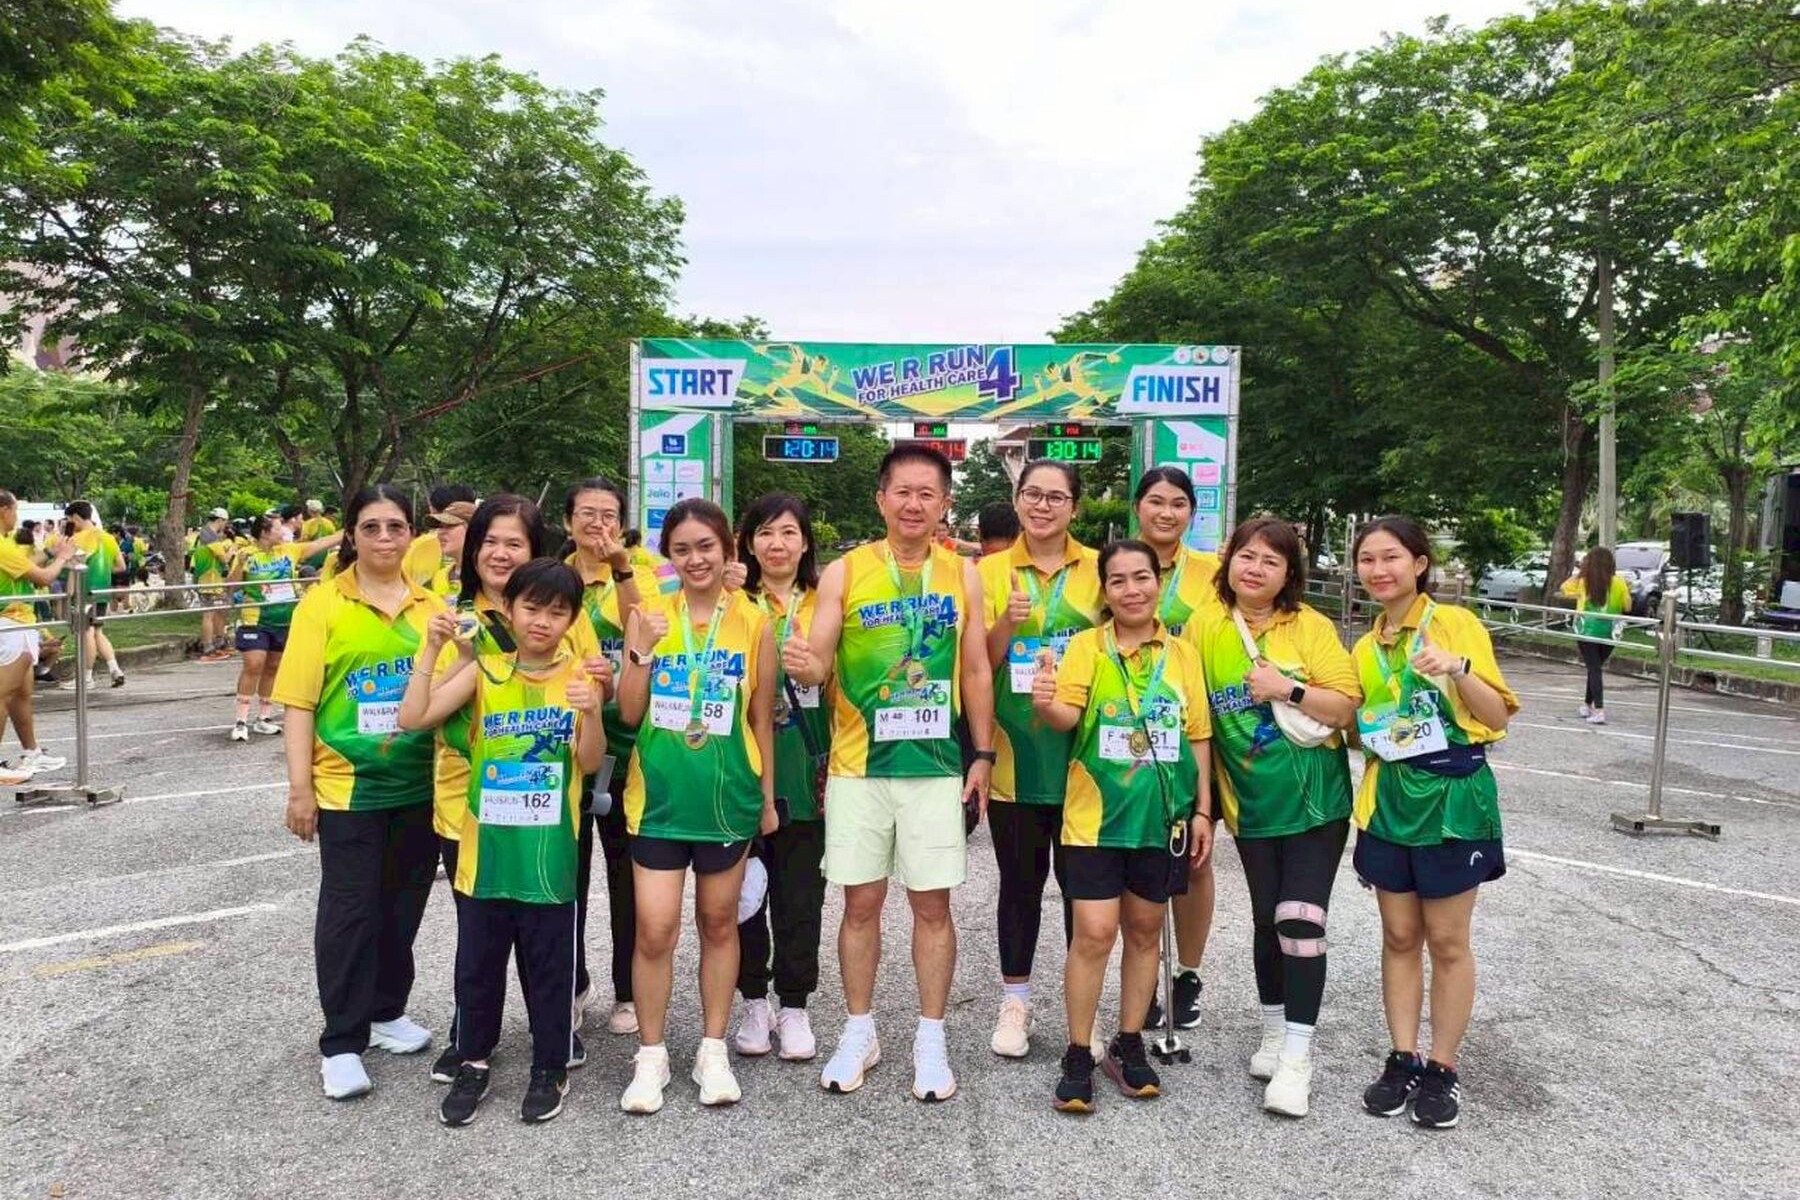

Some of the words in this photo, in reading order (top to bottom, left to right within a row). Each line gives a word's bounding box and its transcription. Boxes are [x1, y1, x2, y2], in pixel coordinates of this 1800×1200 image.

[648, 368, 733, 396] START
[852, 362, 894, 390] WE
[903, 358, 920, 380] R
[928, 346, 985, 375] RUN
[978, 346, 1018, 399] 4
[858, 389, 887, 404] FOR
[890, 377, 944, 399] HEALTH
[946, 369, 986, 386] CARE
[1133, 375, 1220, 403] FINISH
[857, 602, 885, 619] WE
[938, 595, 958, 625] 4
[376, 662, 389, 677] R
[677, 653, 688, 666] R
[723, 652, 745, 681] 4
[507, 711, 519, 723] R
[525, 706, 561, 721] RUN
[554, 710, 575, 741] 4
[704, 703, 724, 719] 58
[880, 712, 889, 722] M
[914, 708, 939, 723] 101
[1107, 731, 1114, 741] F
[1414, 722, 1432, 739] 20
[522, 792, 551, 809] 162
